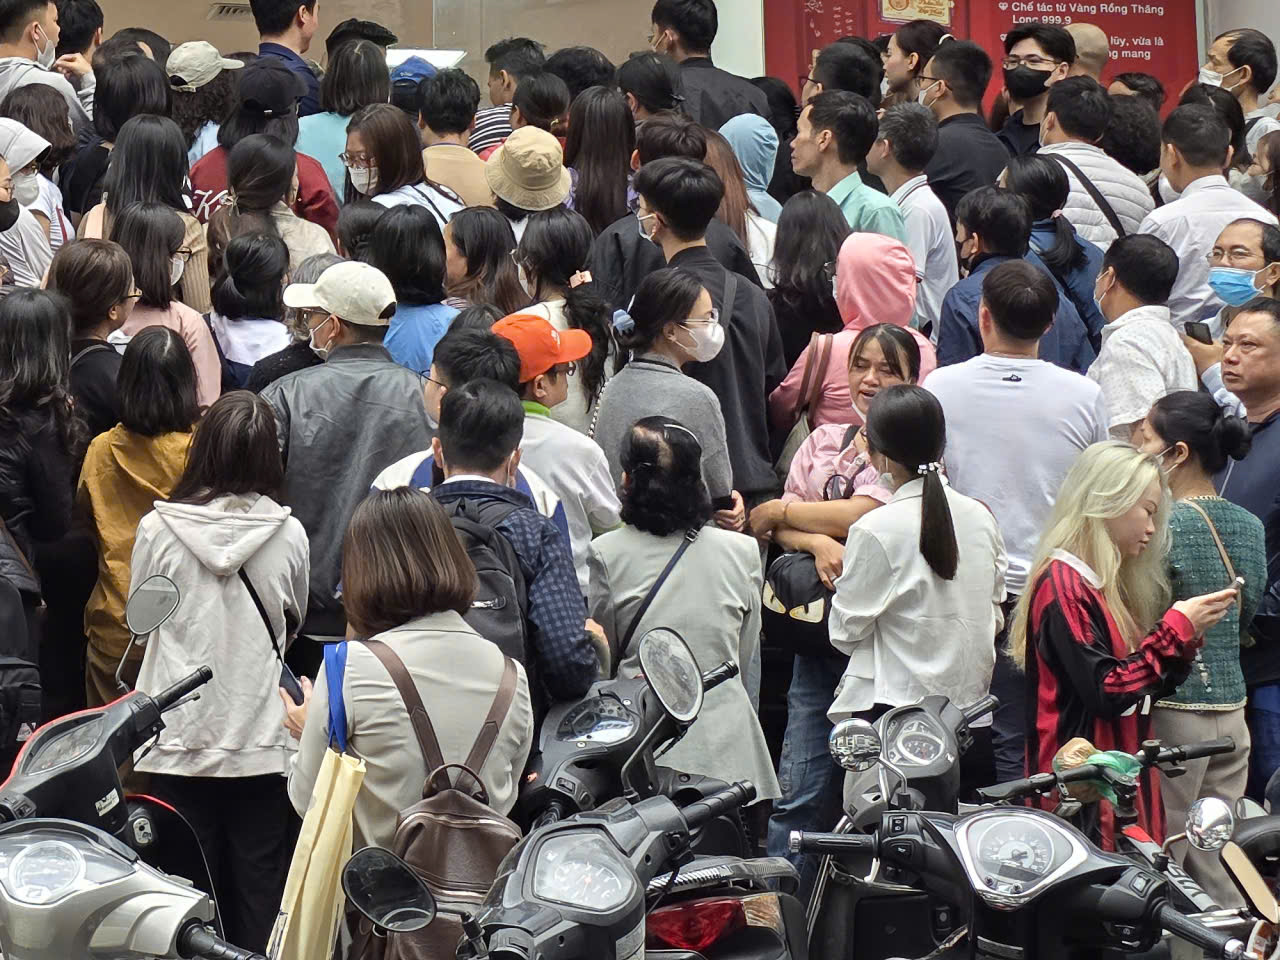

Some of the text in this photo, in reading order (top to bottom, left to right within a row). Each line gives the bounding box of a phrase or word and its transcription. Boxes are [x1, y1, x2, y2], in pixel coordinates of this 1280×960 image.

[1011, 1, 1034, 12] Chế
[1037, 2, 1053, 12] tác
[1069, 3, 1097, 15] Vàng
[1042, 15, 1072, 25] 999.9
[1121, 50, 1151, 60] mang
